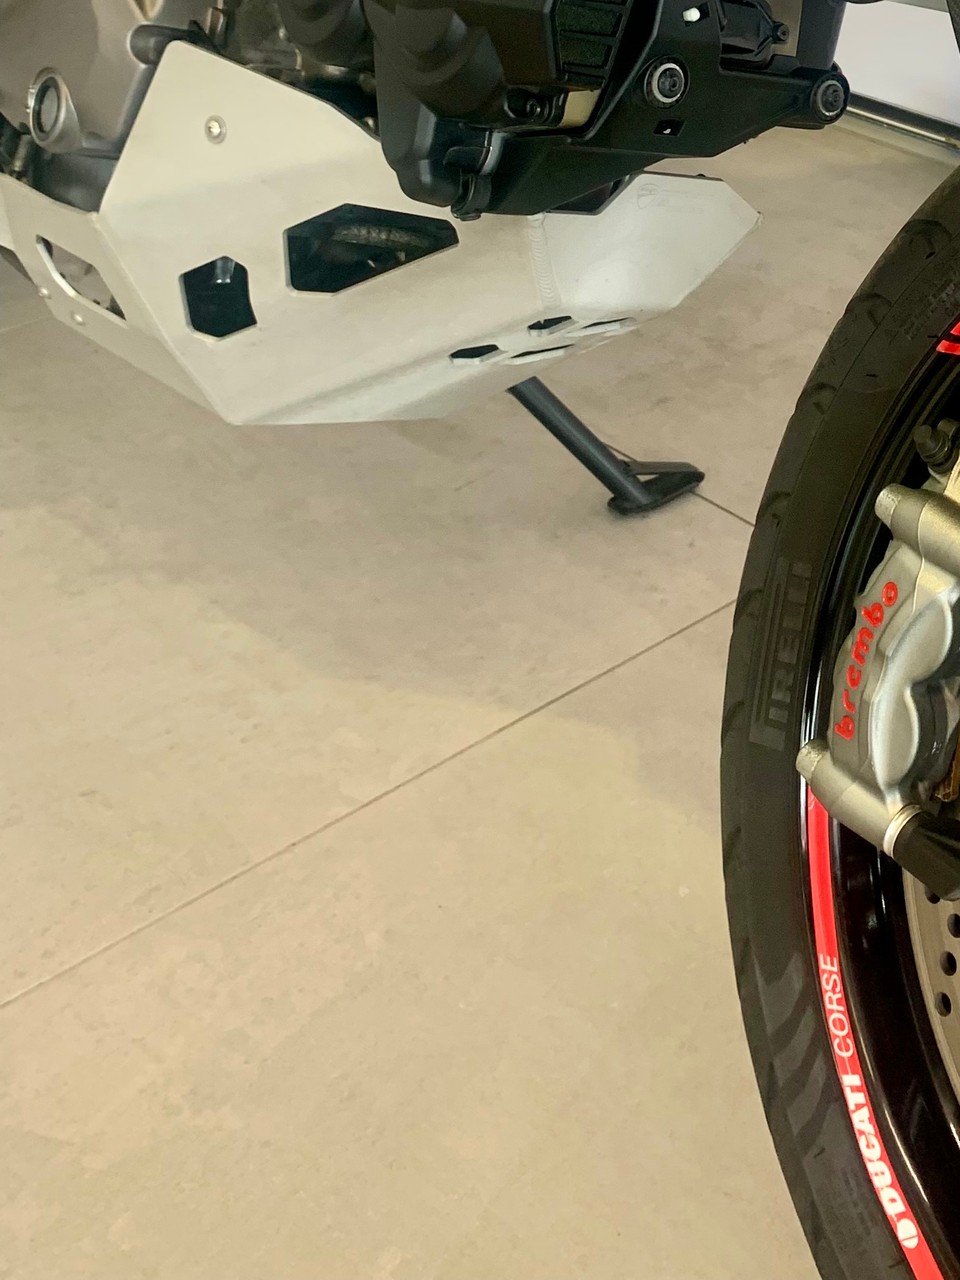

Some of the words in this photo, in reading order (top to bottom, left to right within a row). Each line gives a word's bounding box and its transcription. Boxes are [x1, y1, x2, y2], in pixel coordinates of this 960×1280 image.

[834, 581, 899, 741] brembo
[818, 953, 854, 1058] CORSE
[841, 1074, 907, 1216] DUCATI
